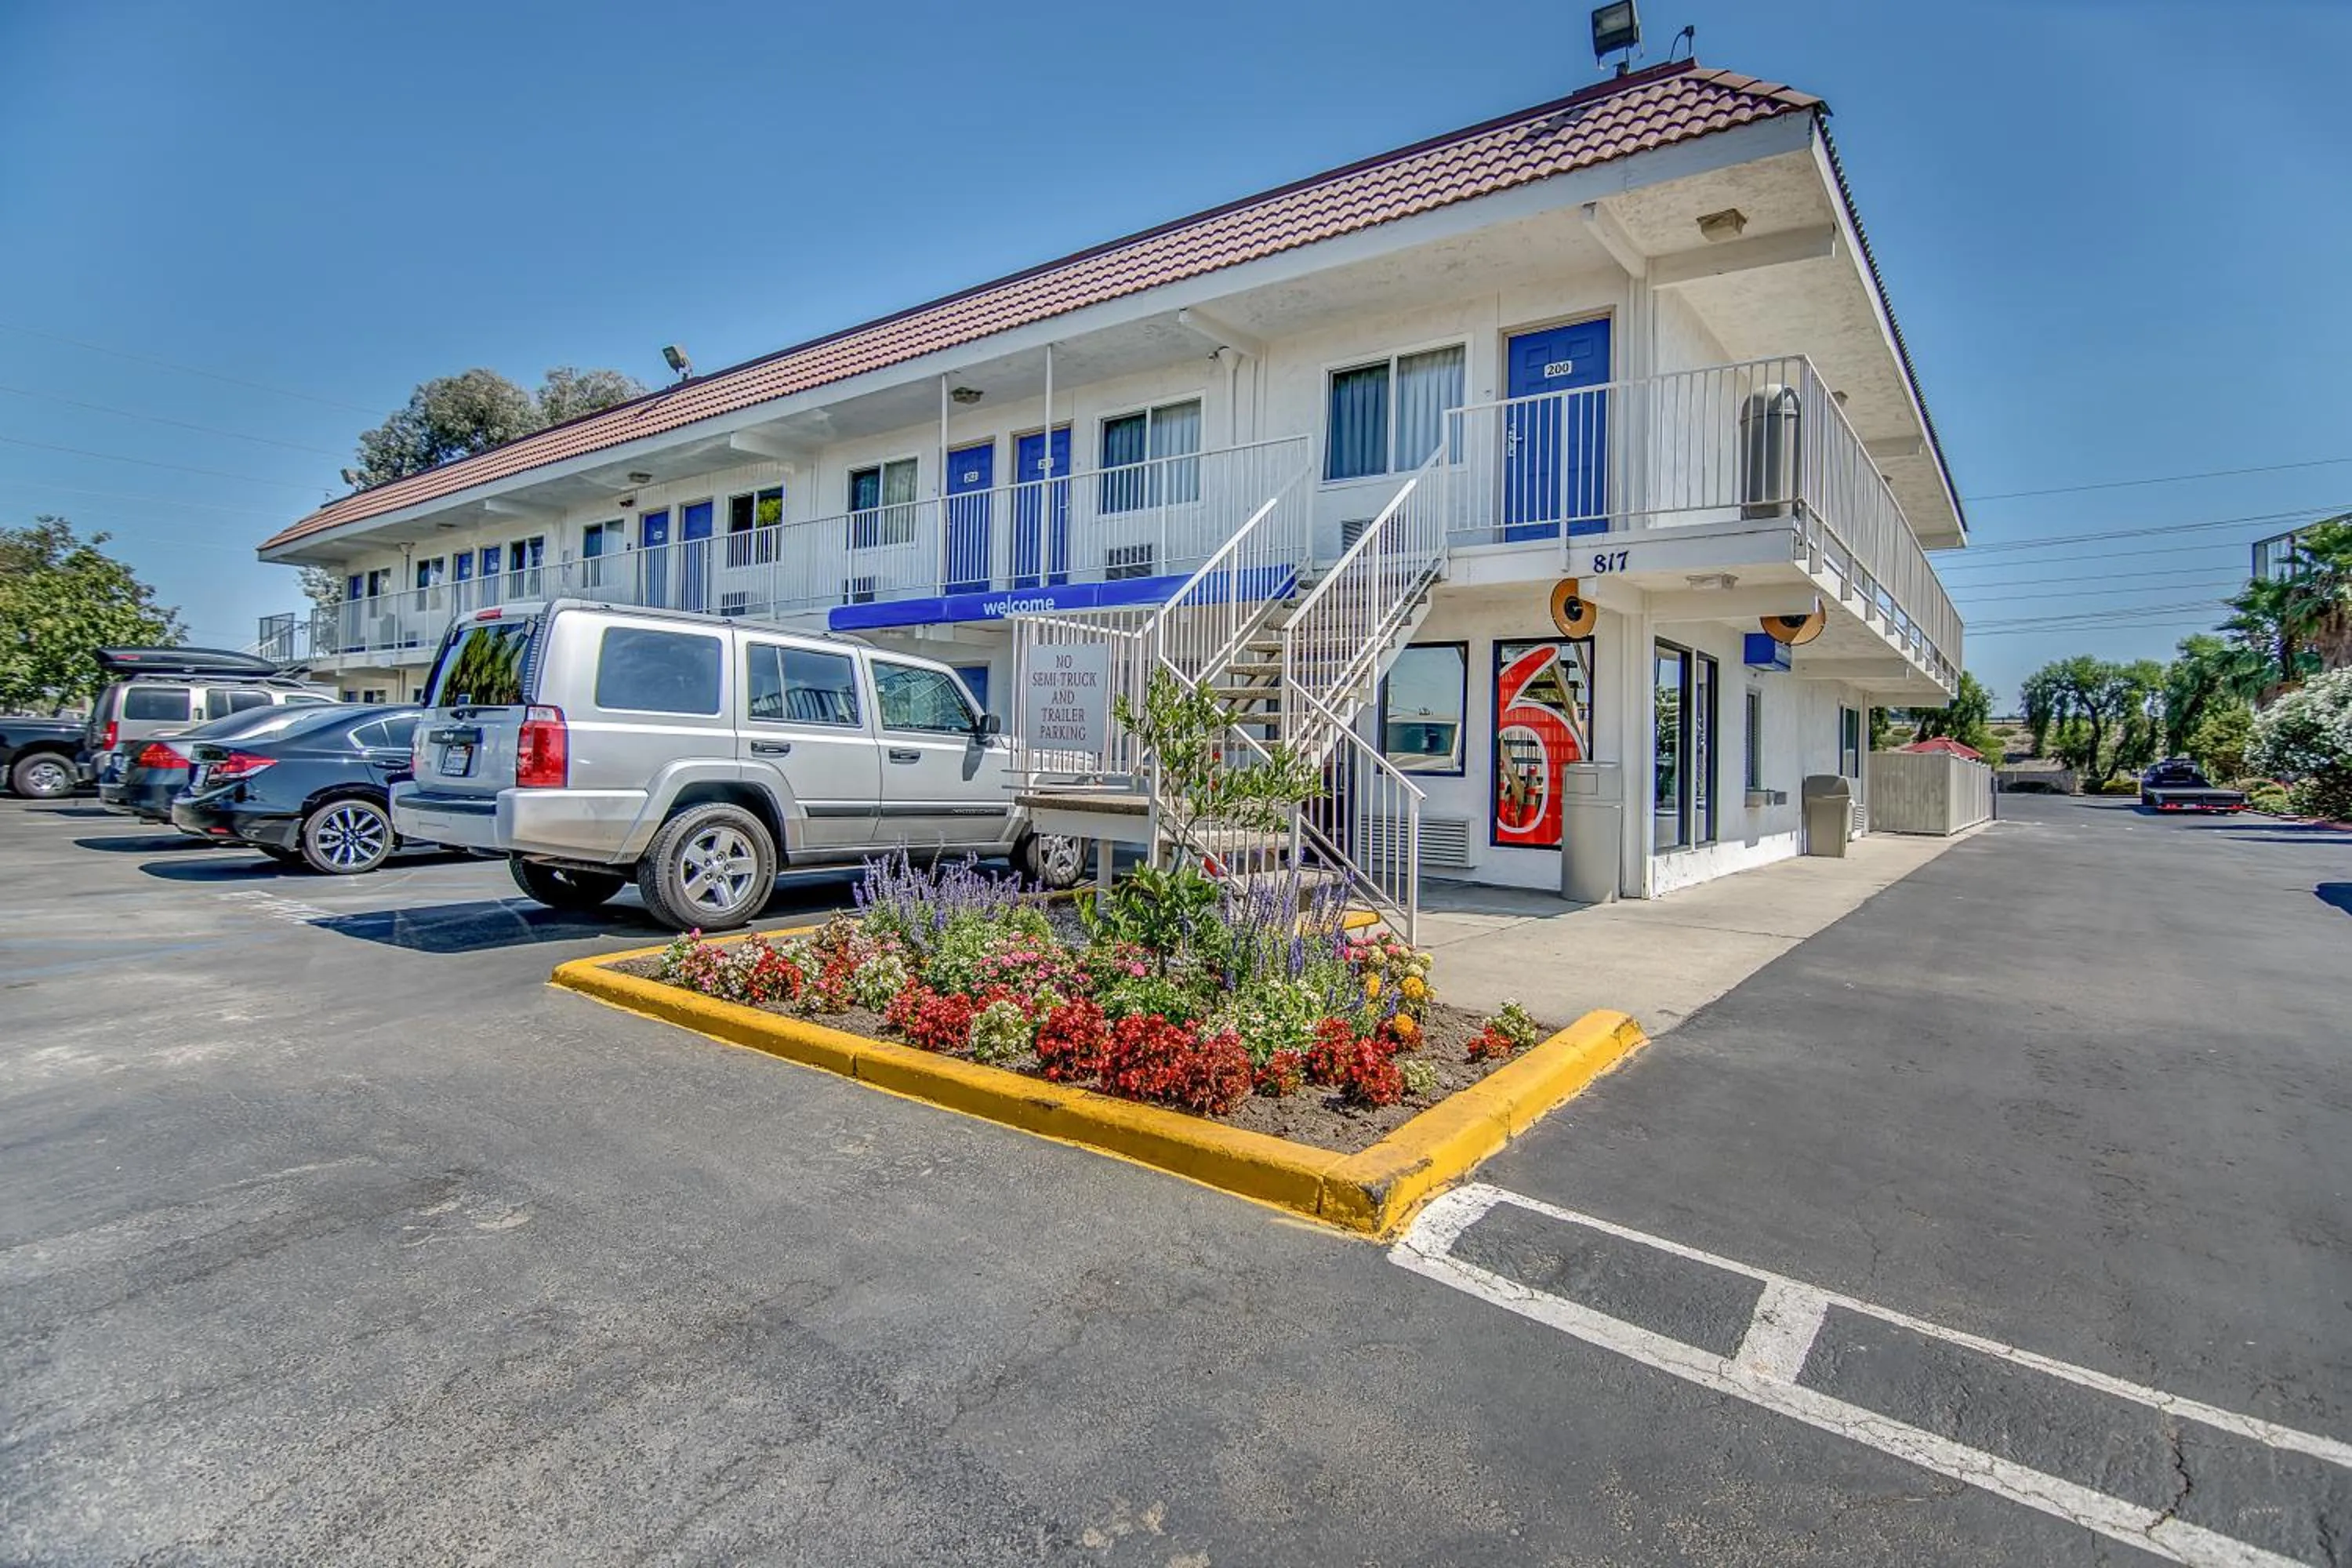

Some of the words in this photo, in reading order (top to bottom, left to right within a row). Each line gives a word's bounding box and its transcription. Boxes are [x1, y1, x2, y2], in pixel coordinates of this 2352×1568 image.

[1548, 363, 1569, 375] 200
[1594, 550, 1629, 574] 817
[982, 594, 1054, 615] welcome
[1055, 655, 1073, 669] NO
[1051, 690, 1075, 704] AND
[1040, 708, 1085, 722] TRAILER
[1040, 725, 1086, 740] PARKING
[1497, 643, 1589, 844] 6
